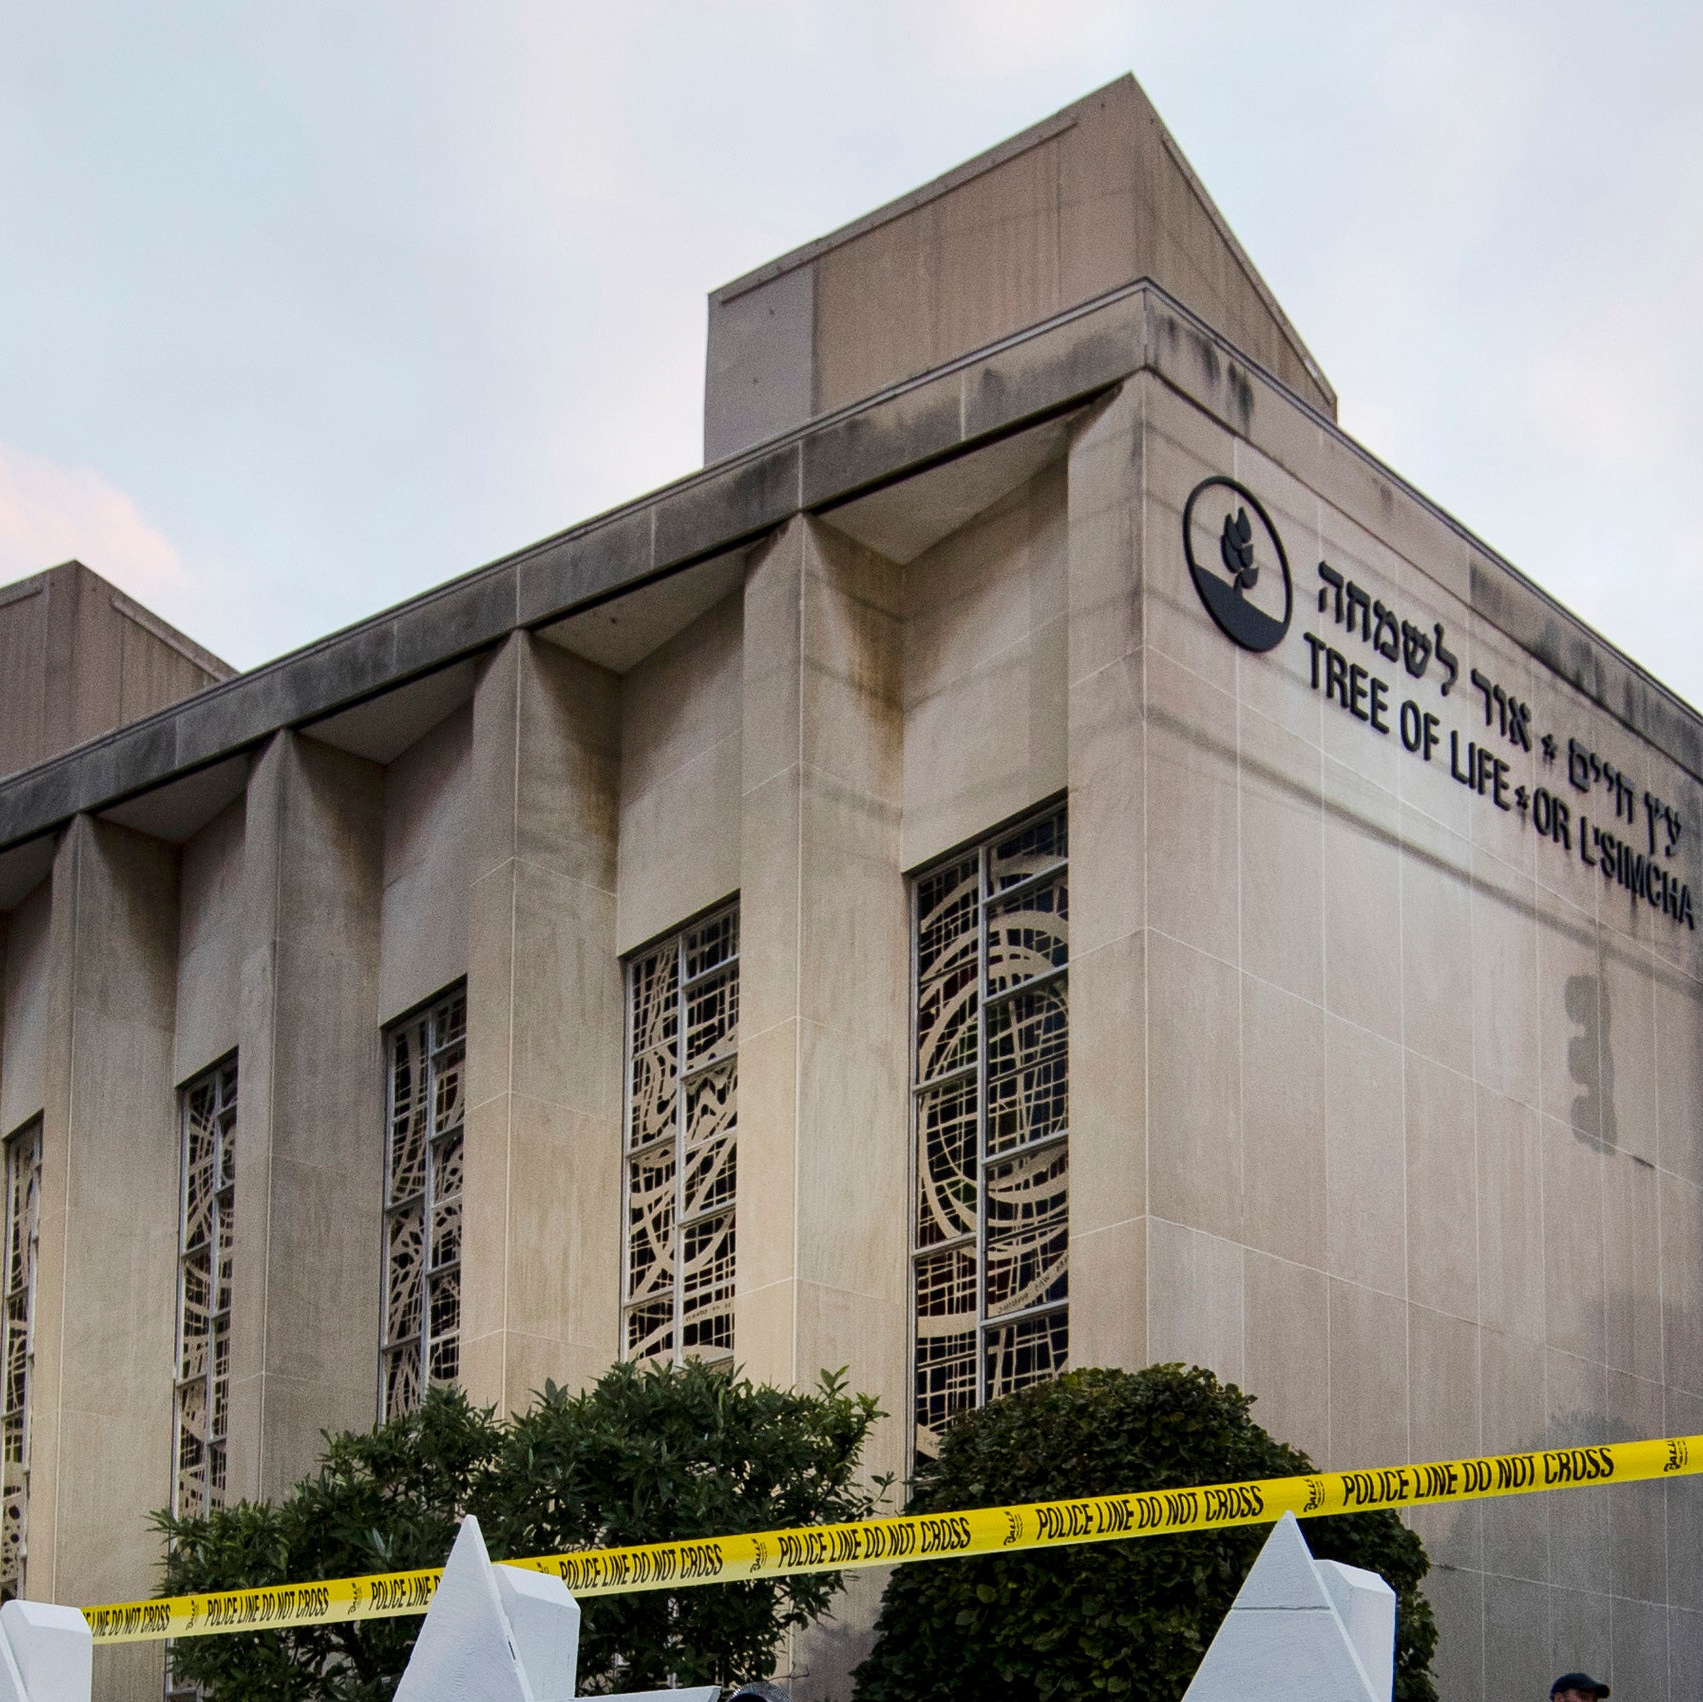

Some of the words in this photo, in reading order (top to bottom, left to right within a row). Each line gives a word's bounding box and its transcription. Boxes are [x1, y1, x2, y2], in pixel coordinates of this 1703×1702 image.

[1317, 560, 1459, 697] לשמחה
[1470, 667, 1532, 752] אור
[1303, 631, 1390, 735] TREE
[1400, 699, 1440, 761] OF
[1450, 729, 1512, 812] LIFE
[1533, 786, 1572, 851] OR
[1579, 815, 1696, 931] L'SIMCHA
[1568, 737, 1635, 825] חיים
[1643, 791, 1682, 857] עץ
[1342, 1470, 1410, 1507] POLICE
[1413, 1464, 1458, 1499] LINE
[1462, 1460, 1492, 1494] DO
[1495, 1455, 1537, 1490] NOT
[1544, 1447, 1615, 1485] CROSS
[1036, 1502, 1094, 1540] POLICE
[1095, 1499, 1134, 1535] LINE
[1137, 1495, 1163, 1528] DO
[1164, 1491, 1199, 1526] NOT
[1205, 1485, 1265, 1519] CROSS
[560, 1558, 599, 1591] POLICE
[601, 1555, 630, 1588] LINE
[632, 1552, 650, 1584] DO
[651, 1549, 676, 1581] NOT
[680, 1543, 723, 1579] CROSS
[778, 1531, 828, 1568] POLICE
[830, 1528, 860, 1562] LINE
[863, 1526, 884, 1559] DO
[887, 1522, 917, 1556] NOT
[921, 1516, 972, 1549] CROSS
[93, 1610, 110, 1637] LINE
[109, 1609, 123, 1636] DO
[122, 1607, 141, 1634] NOT
[141, 1604, 171, 1633] CROSS
[204, 1596, 237, 1626] POLICE
[237, 1594, 260, 1623] LINE
[260, 1593, 277, 1621] DO
[275, 1589, 298, 1620] NOT
[297, 1586, 329, 1618] CROSS
[369, 1578, 407, 1611] POLICE
[405, 1576, 432, 1607] LINE
